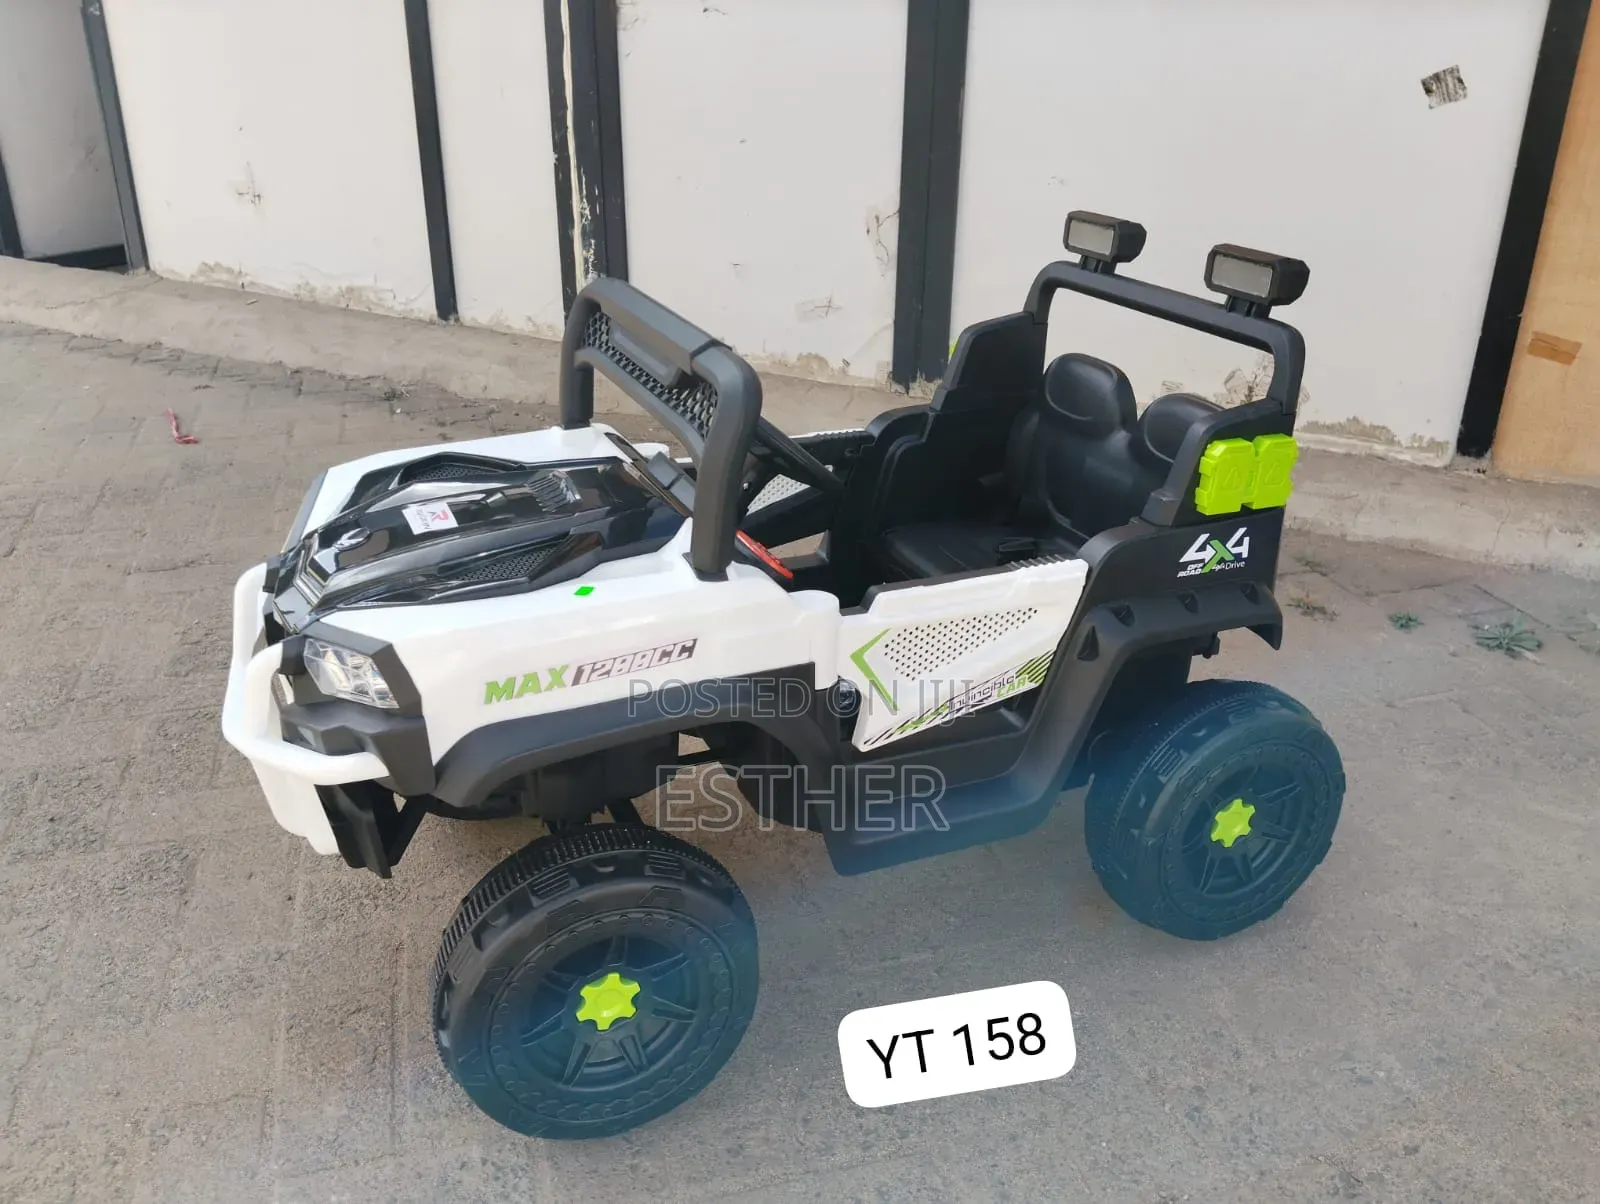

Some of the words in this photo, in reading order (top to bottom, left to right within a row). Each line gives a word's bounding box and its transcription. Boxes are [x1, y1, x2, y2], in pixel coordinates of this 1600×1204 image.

[1176, 568, 1203, 578] ROAD
[484, 664, 570, 704] MAX
[997, 676, 1028, 699] CAR
